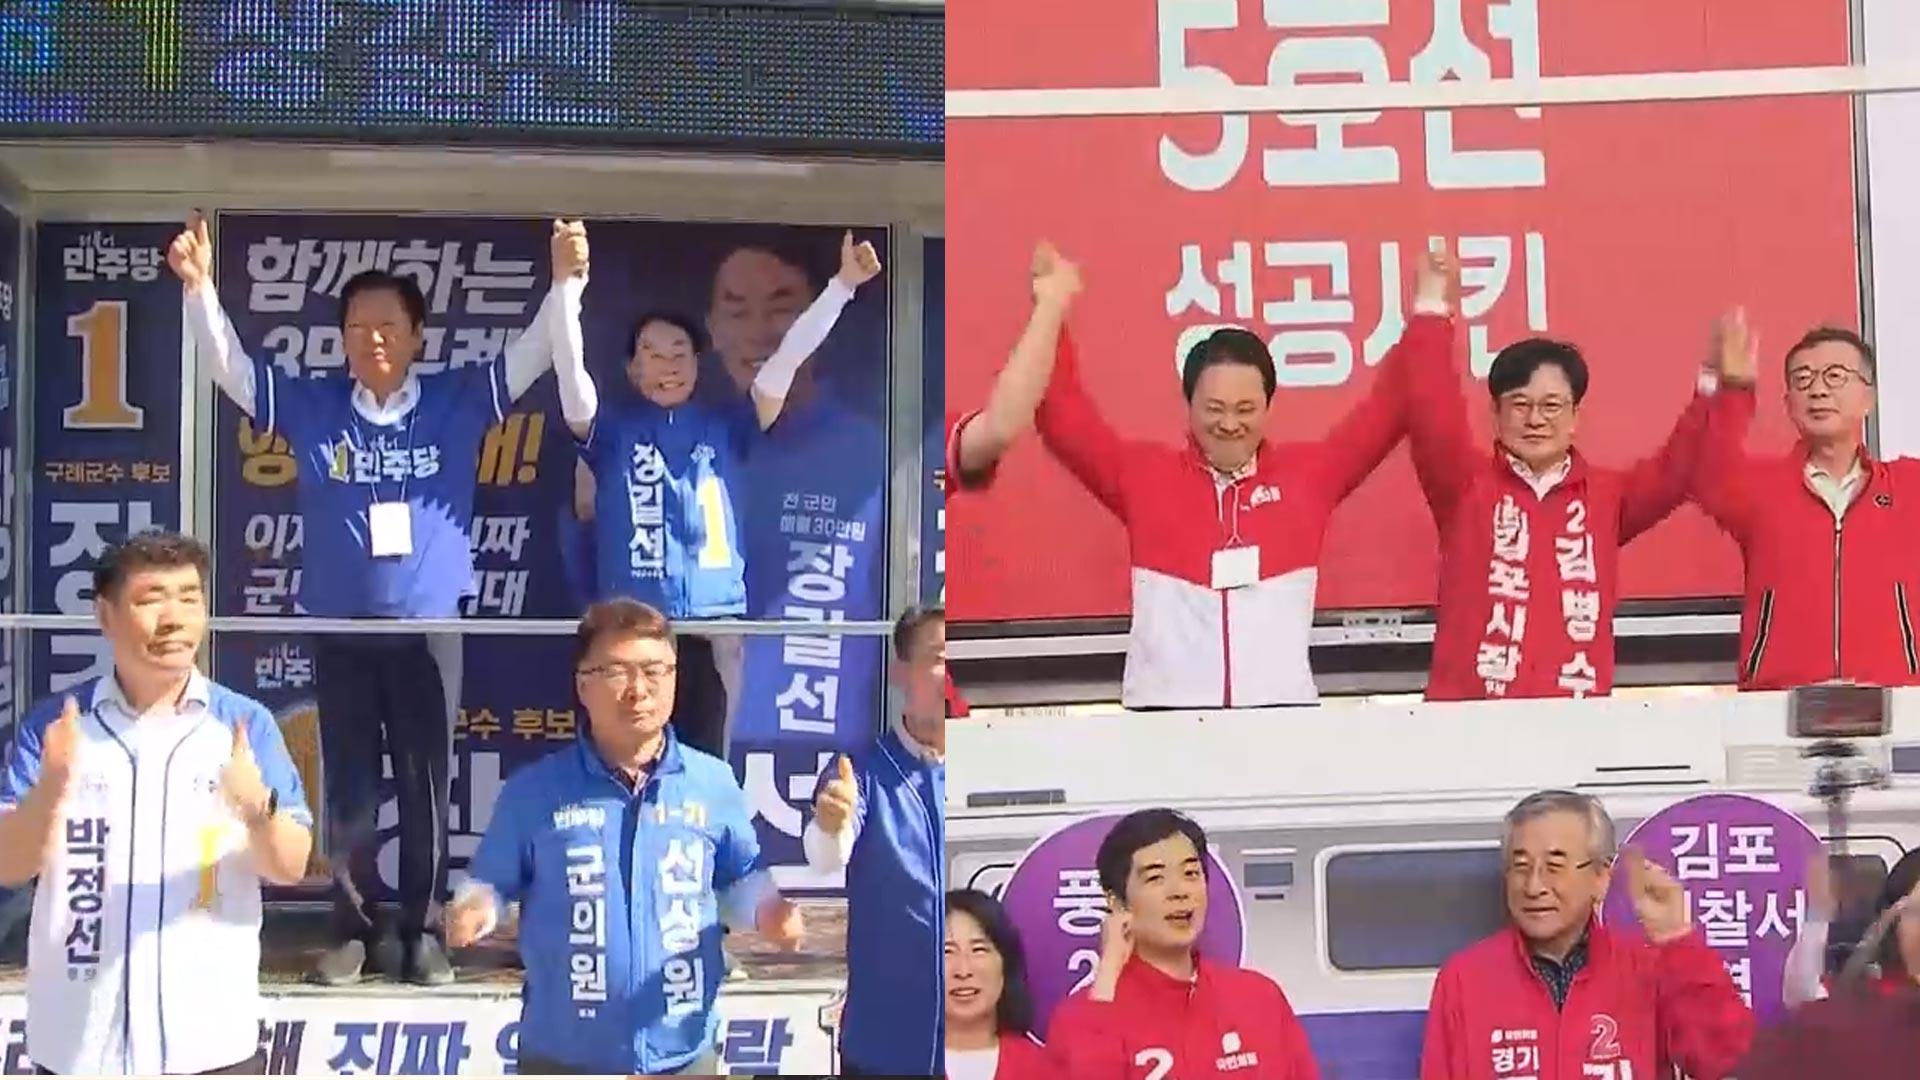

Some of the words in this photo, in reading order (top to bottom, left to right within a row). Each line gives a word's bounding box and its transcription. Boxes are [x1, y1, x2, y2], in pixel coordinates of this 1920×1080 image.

[63, 246, 165, 281] 민주당
[246, 237, 536, 314] 함께하는
[63, 300, 145, 430] 1
[354, 445, 440, 483] 민주당
[694, 474, 732, 569] 1
[1566, 499, 1586, 533] 2
[776, 541, 856, 735] 장길선
[254, 657, 317, 688] 민주
[512, 708, 576, 740] 후보
[1670, 822, 1781, 880] 김포
[65, 817, 110, 964] 박정선
[1683, 888, 1807, 947] 찰서
[565, 844, 607, 1002] 군의원
[1491, 1046, 1540, 1073] 경기
[1590, 1013, 1622, 1059] 2
